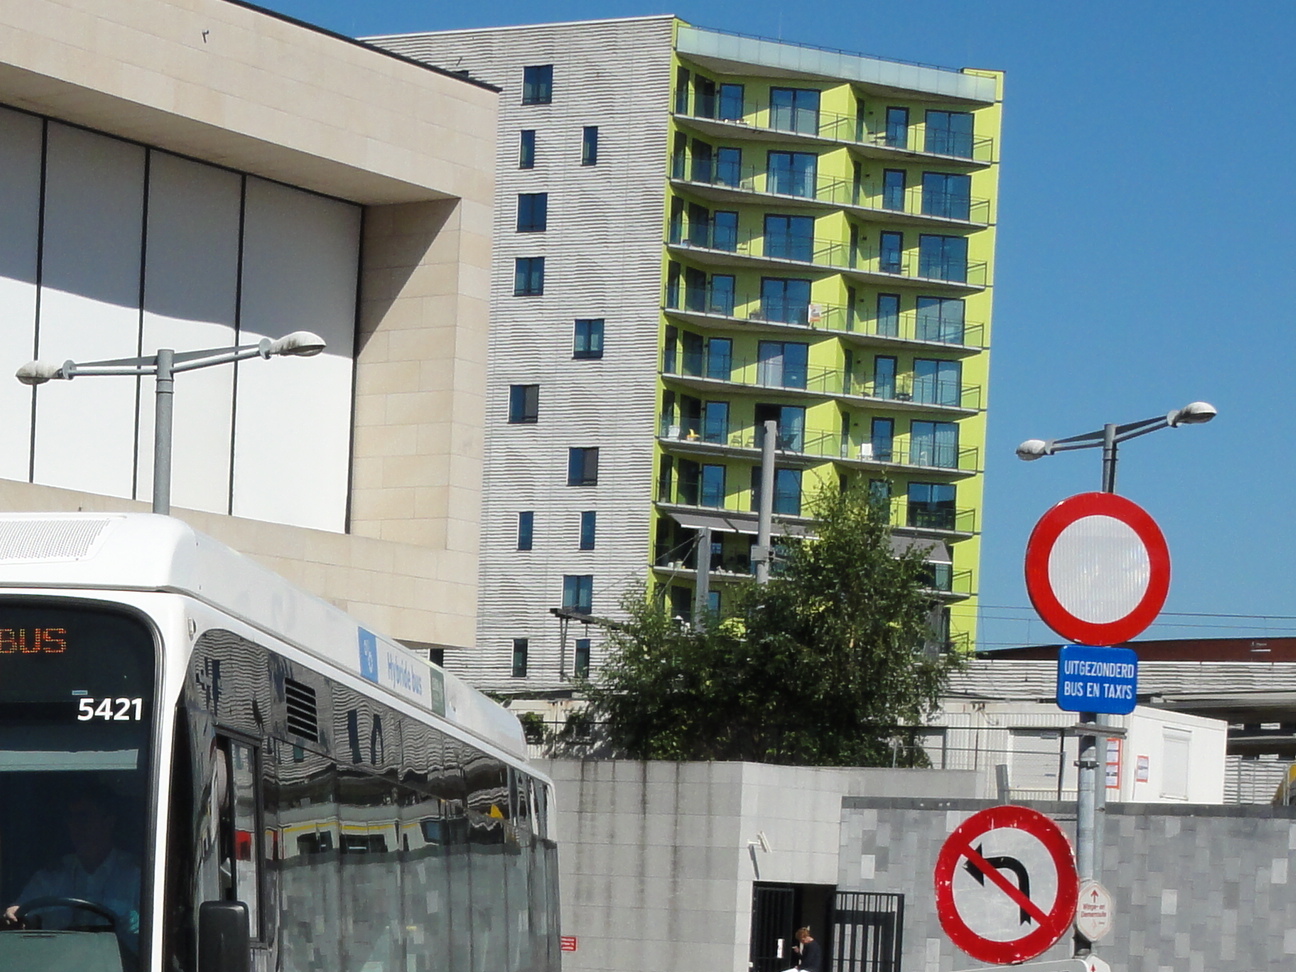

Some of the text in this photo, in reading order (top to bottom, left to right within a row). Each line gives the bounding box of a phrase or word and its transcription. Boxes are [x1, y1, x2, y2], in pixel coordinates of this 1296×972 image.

[1064, 659, 1135, 679] UITGEZONDERD
[1064, 682, 1133, 700] BUS EN TAXI'S
[77, 697, 143, 722] 5421
